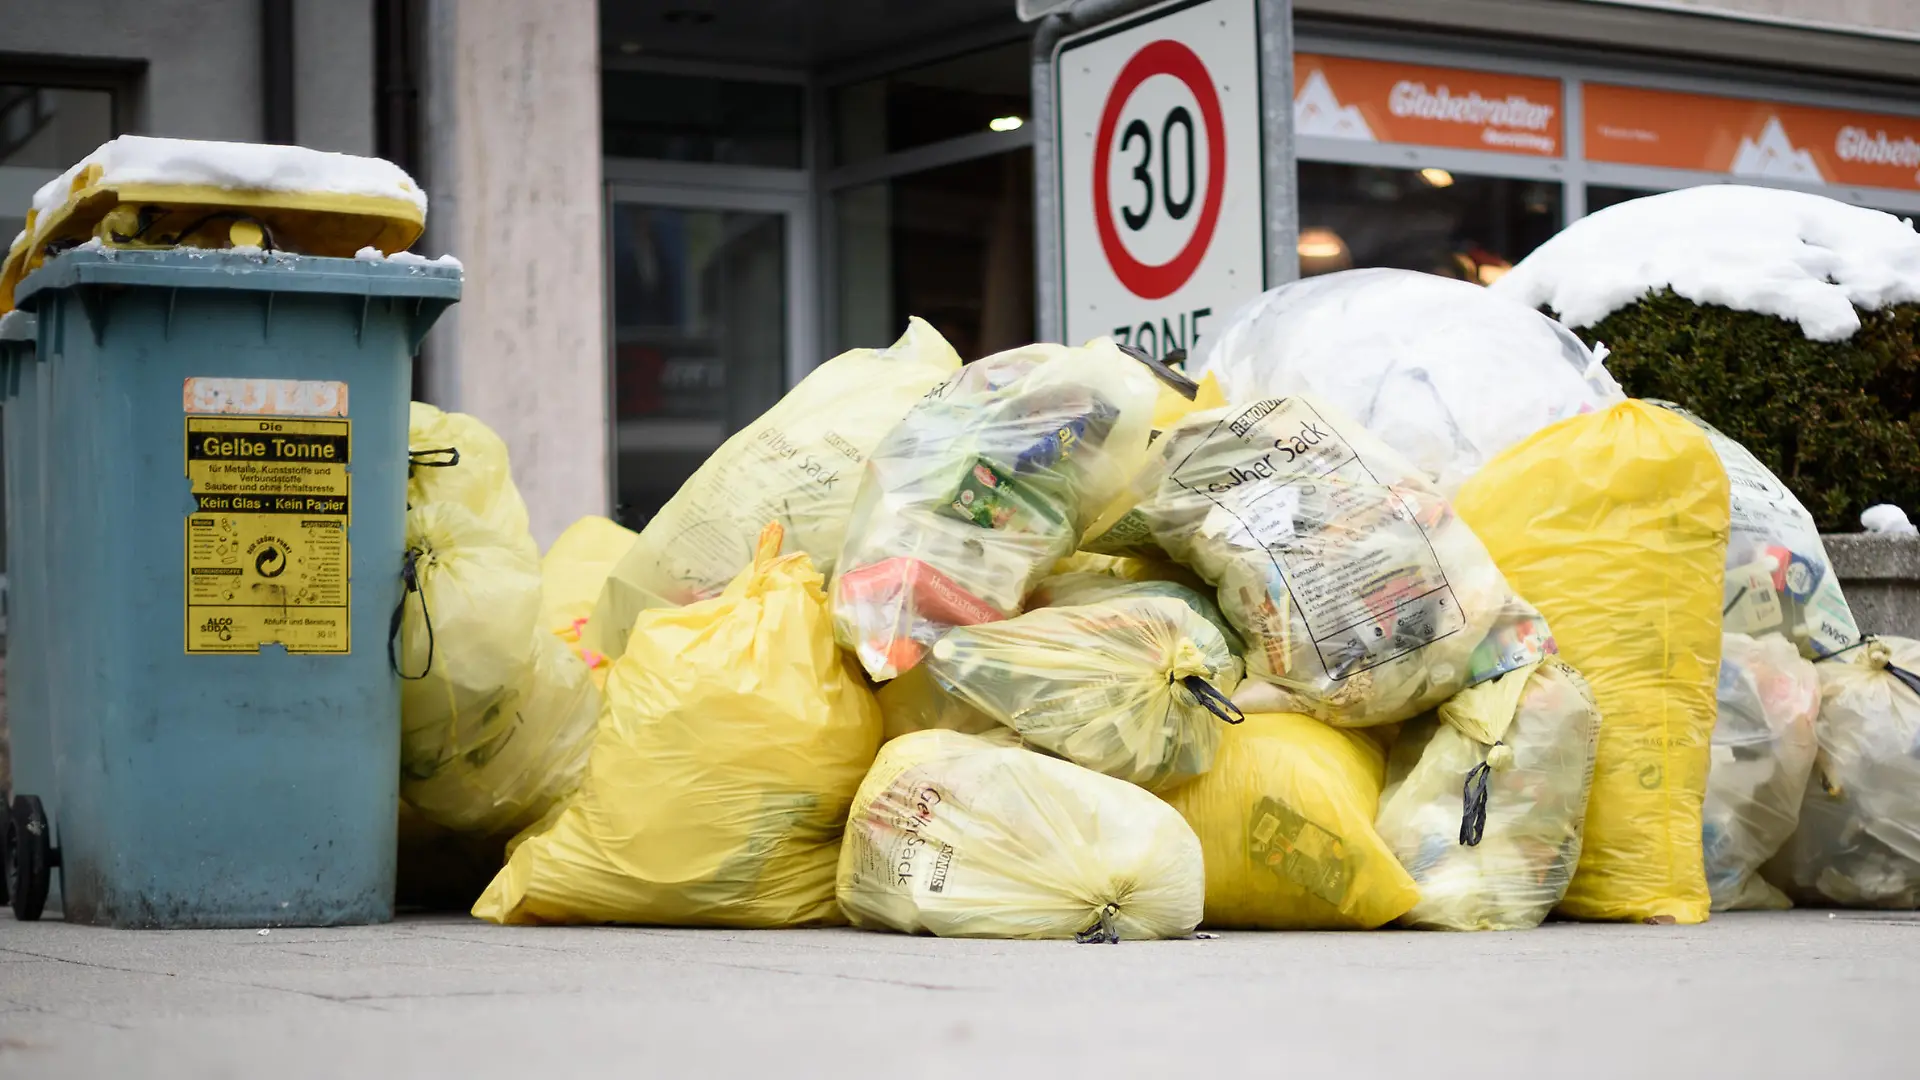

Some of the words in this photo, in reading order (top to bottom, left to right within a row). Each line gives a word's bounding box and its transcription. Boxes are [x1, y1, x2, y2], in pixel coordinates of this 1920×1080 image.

[1835, 126, 1919, 168] Globet
[1121, 106, 1195, 231] 30
[1231, 399, 1286, 436] REMOND
[259, 422, 283, 432] Die
[203, 437, 266, 456] Gelbe
[271, 439, 335, 458] Tonne
[1274, 421, 1328, 463] Sack
[209, 465, 222, 473] für
[261, 466, 312, 475] Kunststoffe
[314, 467, 331, 475] und
[240, 474, 302, 483] Verbundstoffe
[798, 455, 839, 490] Sack
[204, 482, 238, 491] Sauber
[240, 483, 257, 491] und
[259, 483, 281, 492] ohne
[284, 484, 334, 493] Inhaltsreste
[200, 497, 229, 509] Kein
[232, 497, 261, 509] Glas
[275, 499, 303, 510] Kein
[306, 499, 345, 511] Papier
[207, 617, 233, 625] ALCO
[304, 619, 336, 627] Beratung
[897, 837, 926, 886] Sack
